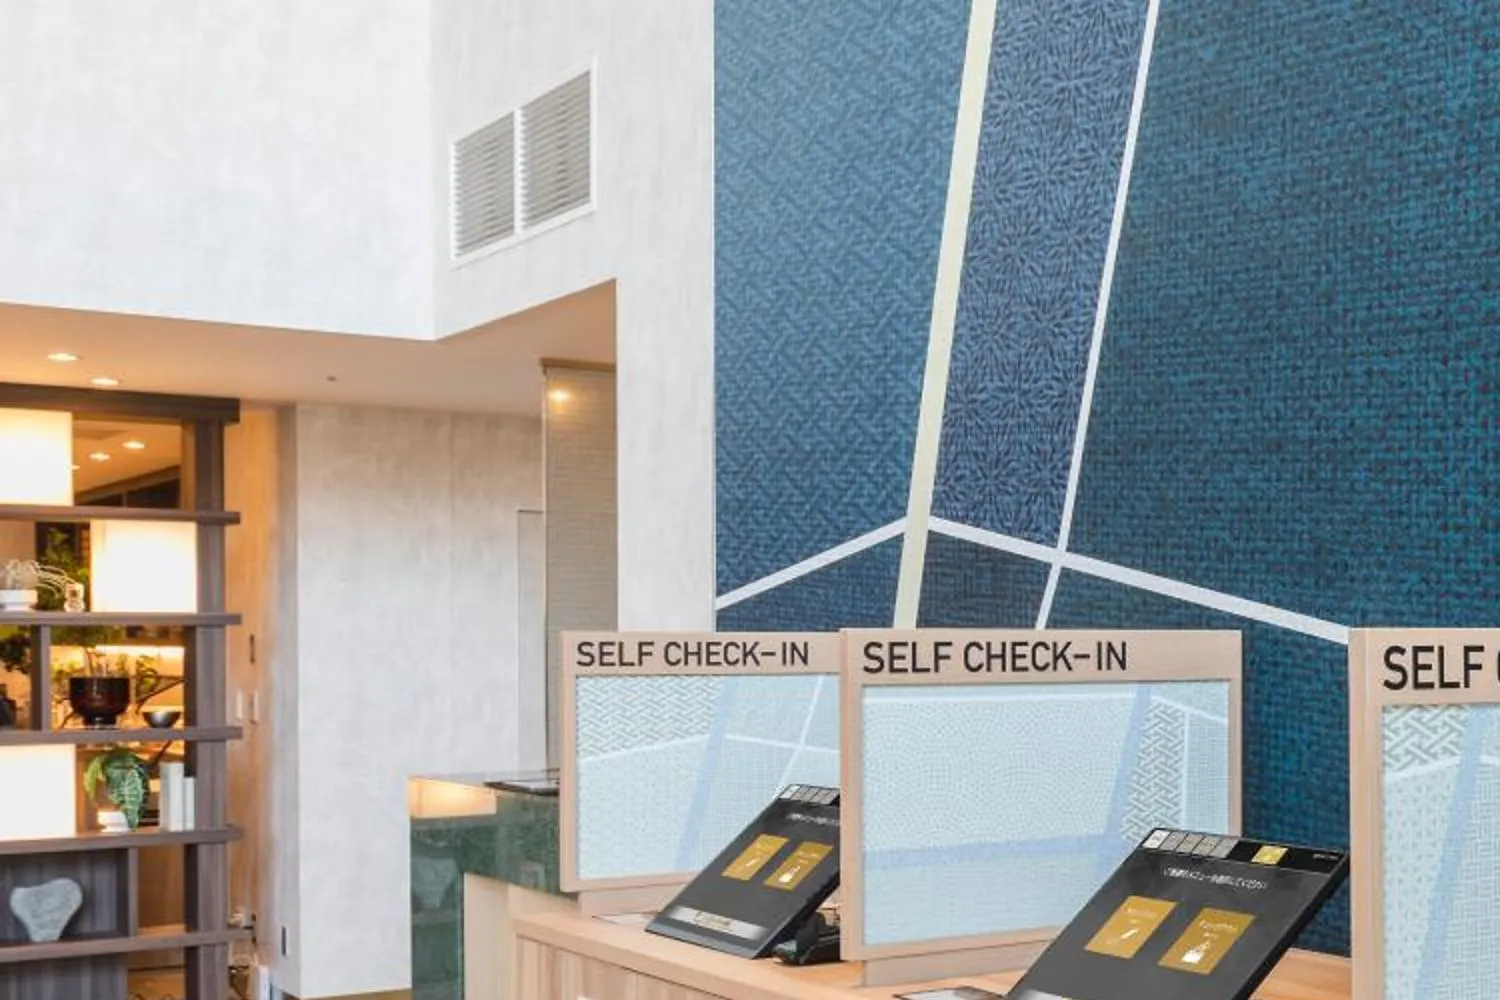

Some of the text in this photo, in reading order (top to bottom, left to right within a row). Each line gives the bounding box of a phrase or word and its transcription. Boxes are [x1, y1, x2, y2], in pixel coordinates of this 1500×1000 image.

[576, 640, 809, 667] SELF CHECK-IN
[863, 640, 1127, 674] SELF CHECK-IN
[1382, 644, 1485, 690] SELF
